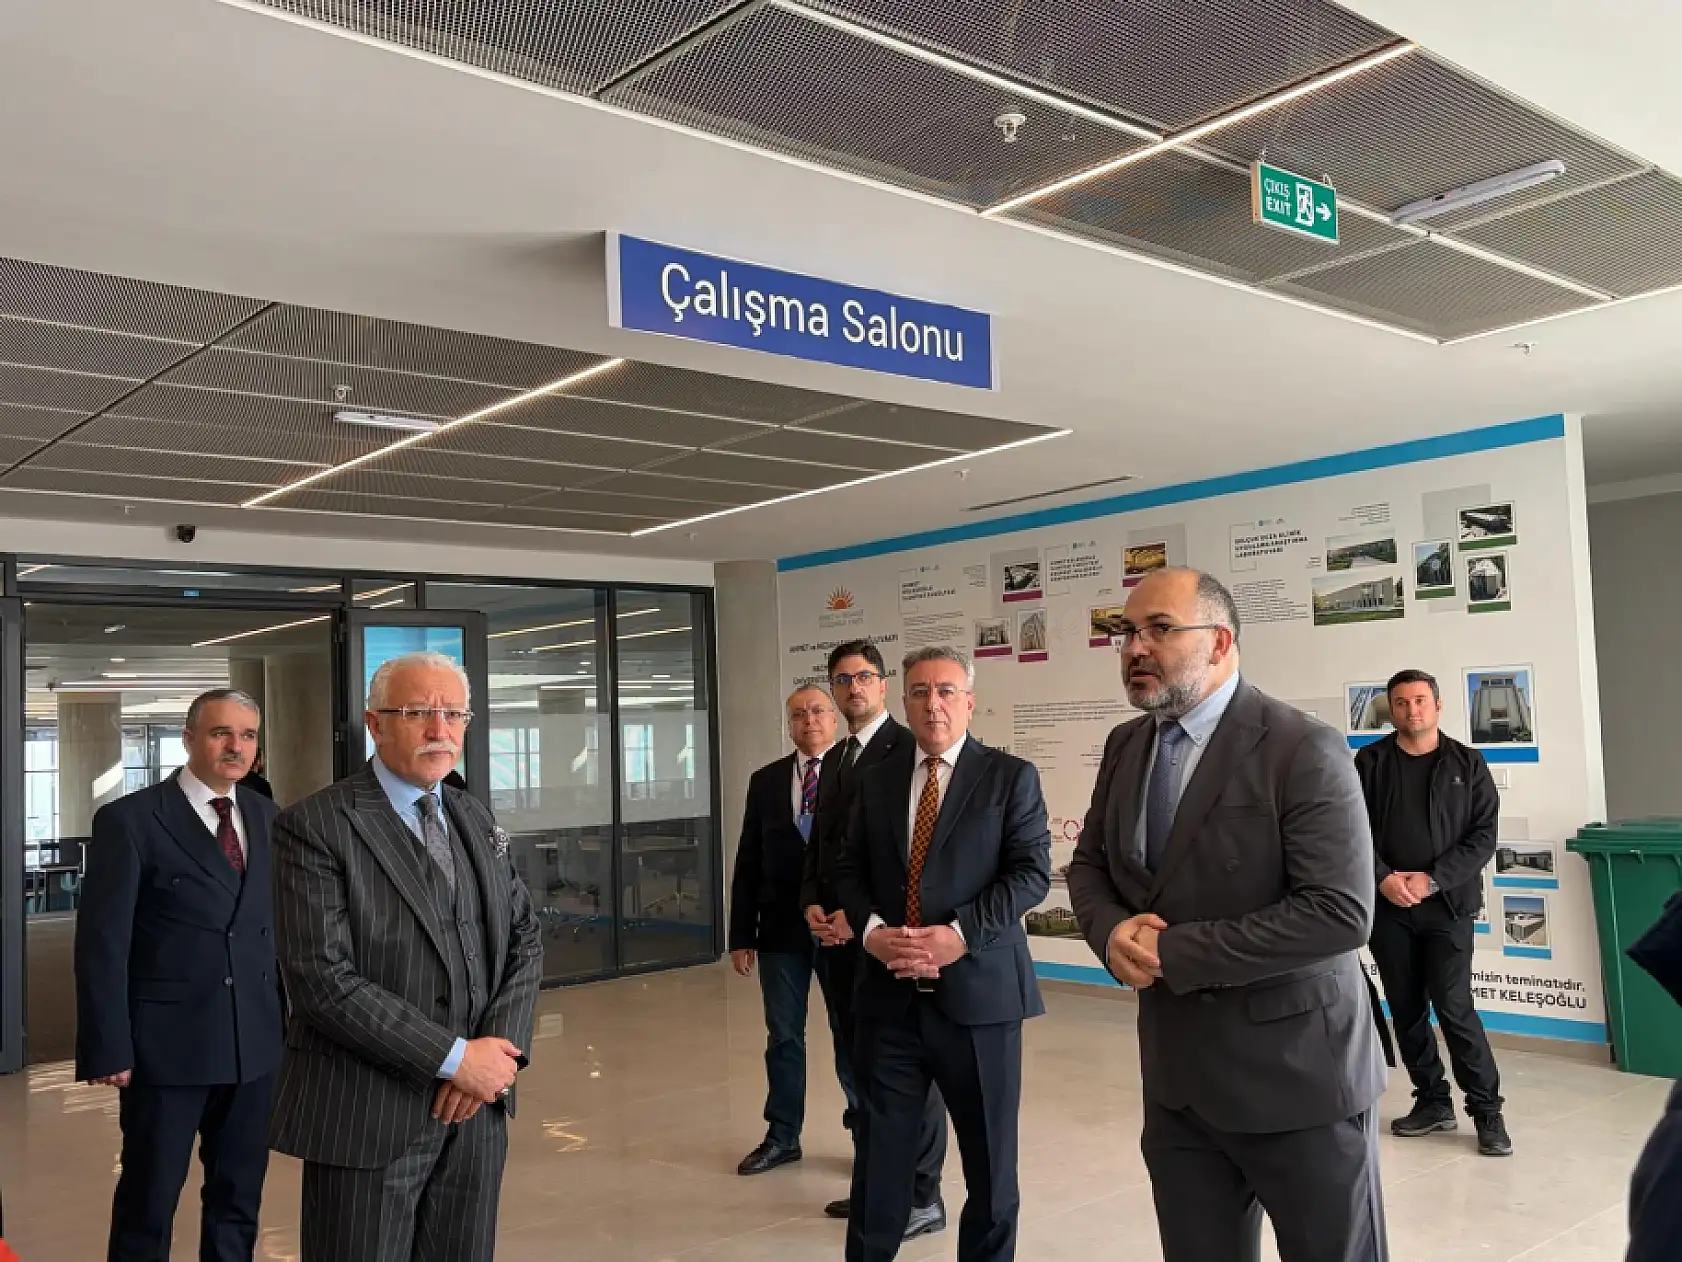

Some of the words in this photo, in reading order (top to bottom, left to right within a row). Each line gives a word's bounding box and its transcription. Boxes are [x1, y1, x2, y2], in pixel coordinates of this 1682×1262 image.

[1266, 197, 1291, 217] EXIT
[661, 262, 829, 336] Çalışma
[842, 299, 963, 361] Salonu
[1500, 989, 1586, 1009] KELEŞOĞLU
